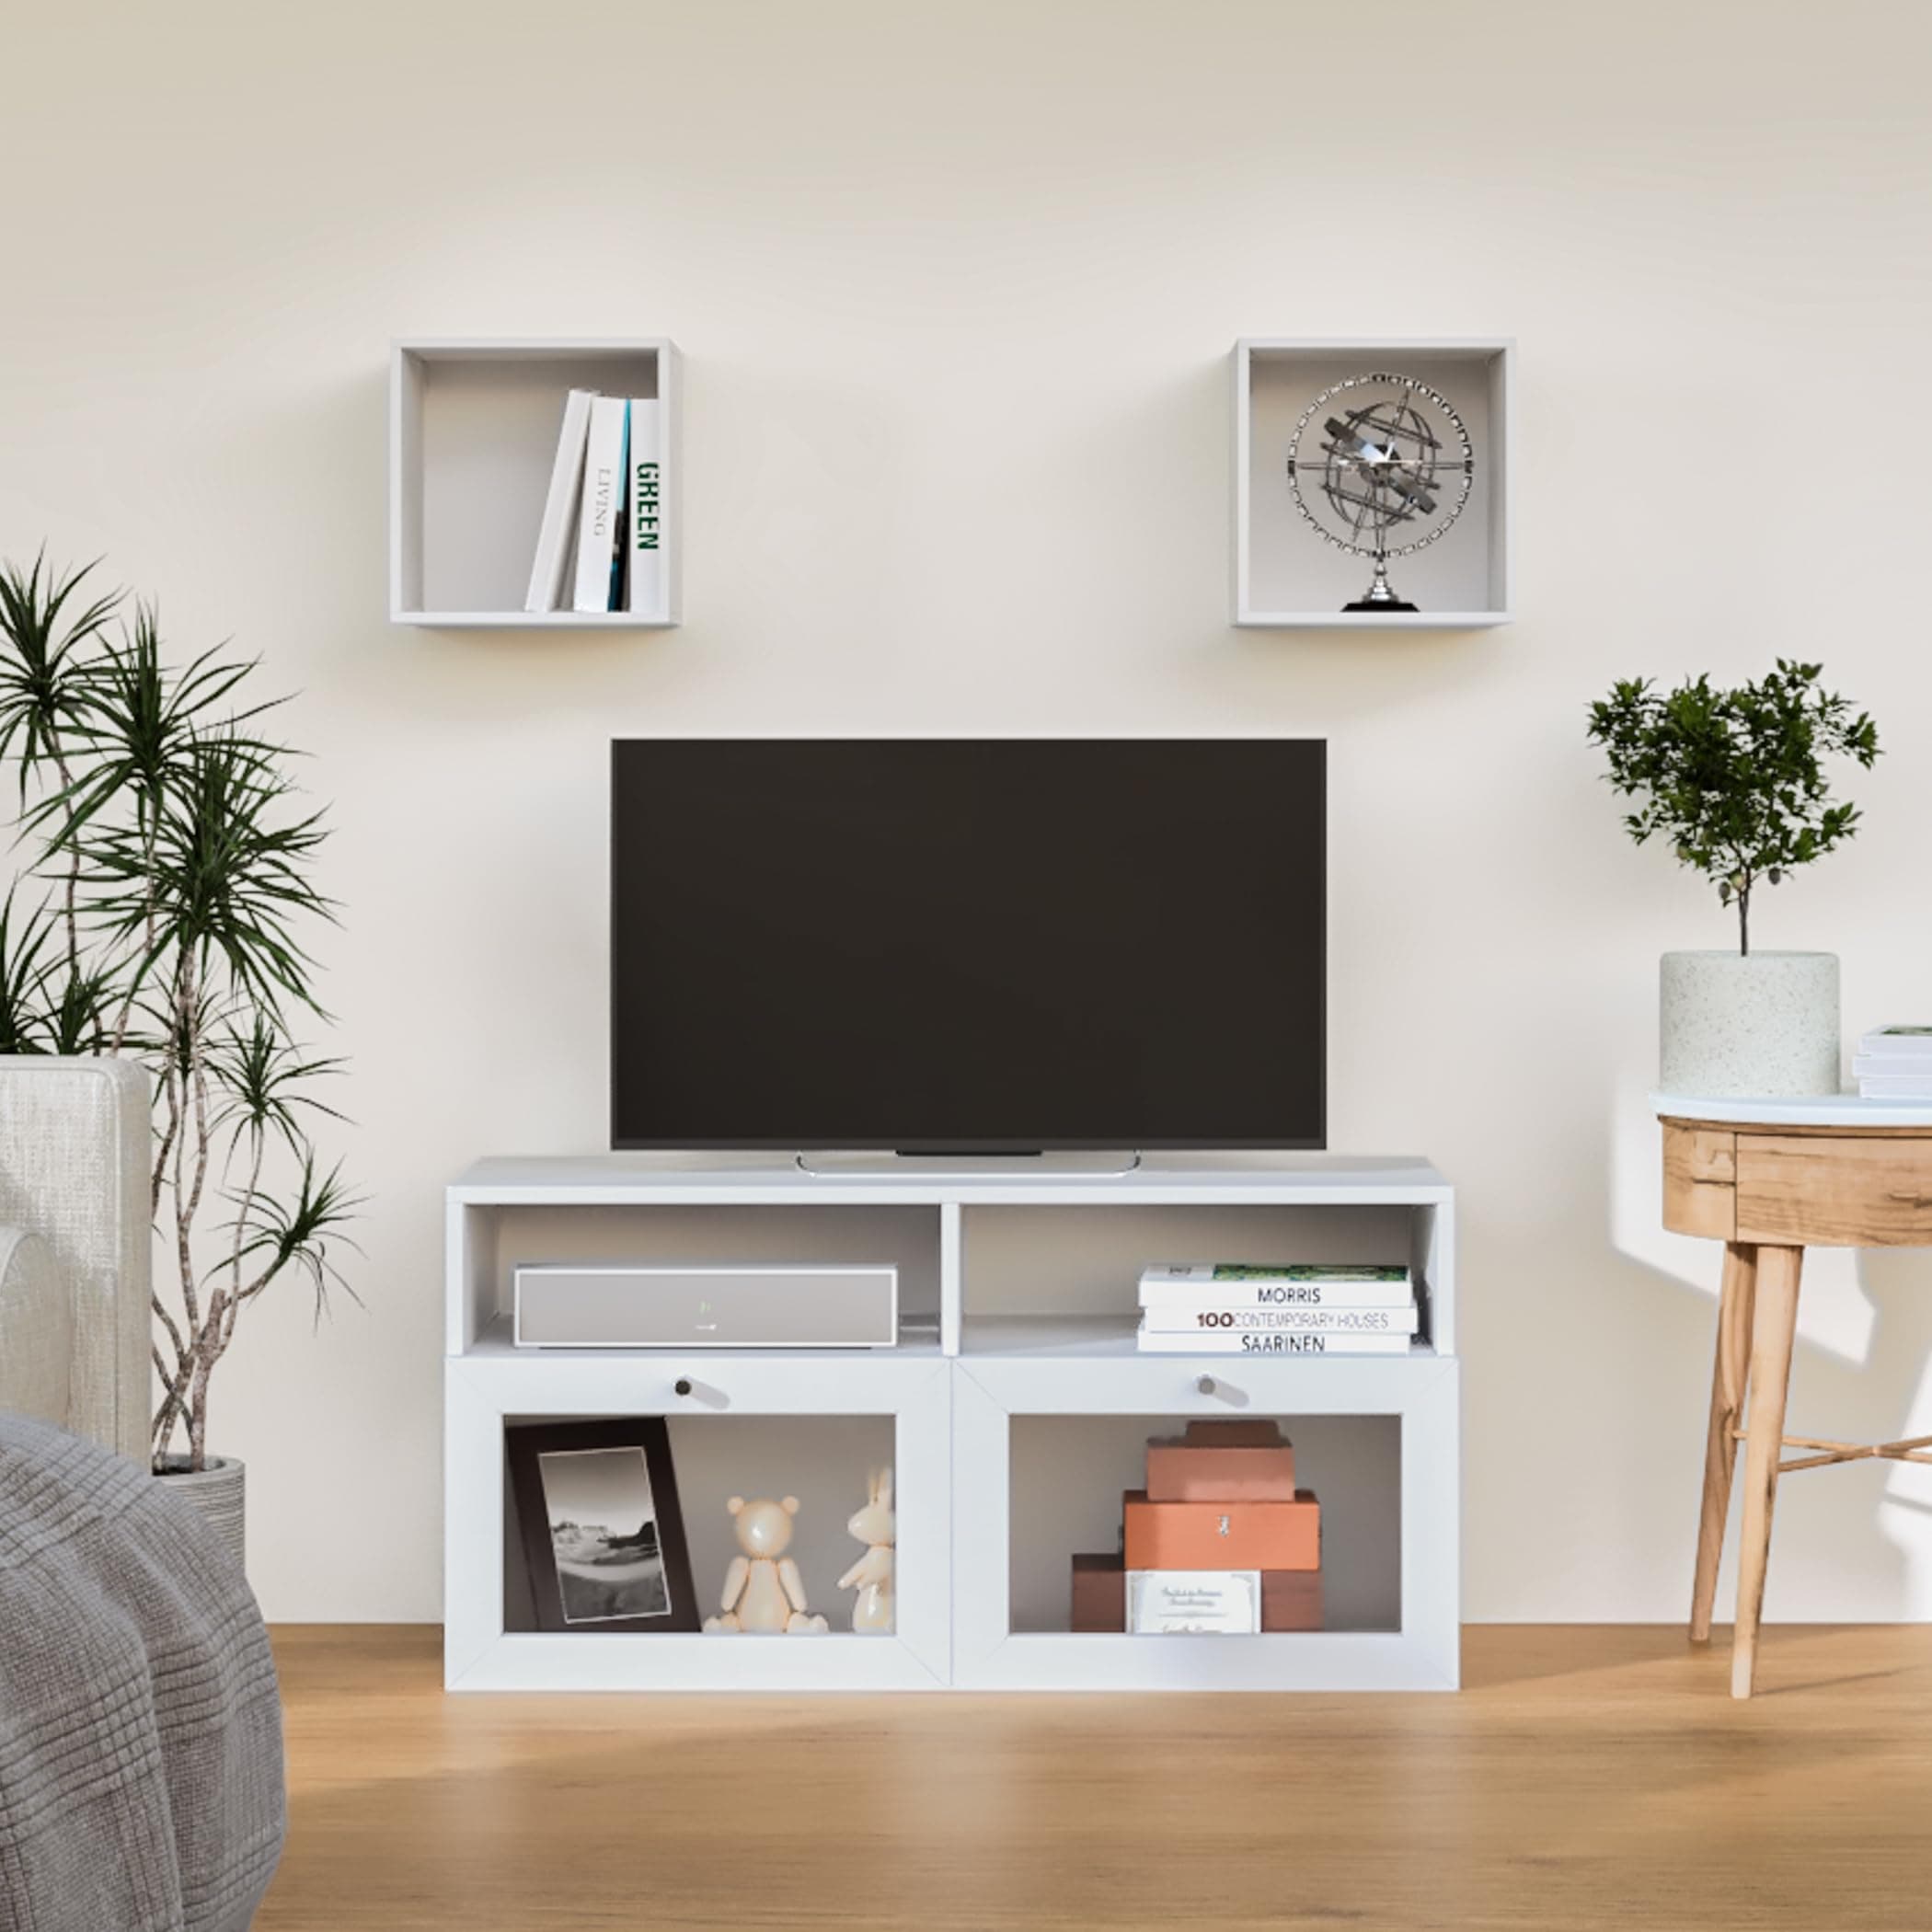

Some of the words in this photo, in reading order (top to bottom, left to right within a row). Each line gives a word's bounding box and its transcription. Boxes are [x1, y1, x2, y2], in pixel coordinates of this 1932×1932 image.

[593, 468, 611, 536] LIVING
[637, 462, 659, 550] GREEN
[1258, 1287, 1321, 1304] MORRIS
[1337, 1313, 1388, 1328] HOUSES
[1242, 1335, 1325, 1352] SAARINEN
